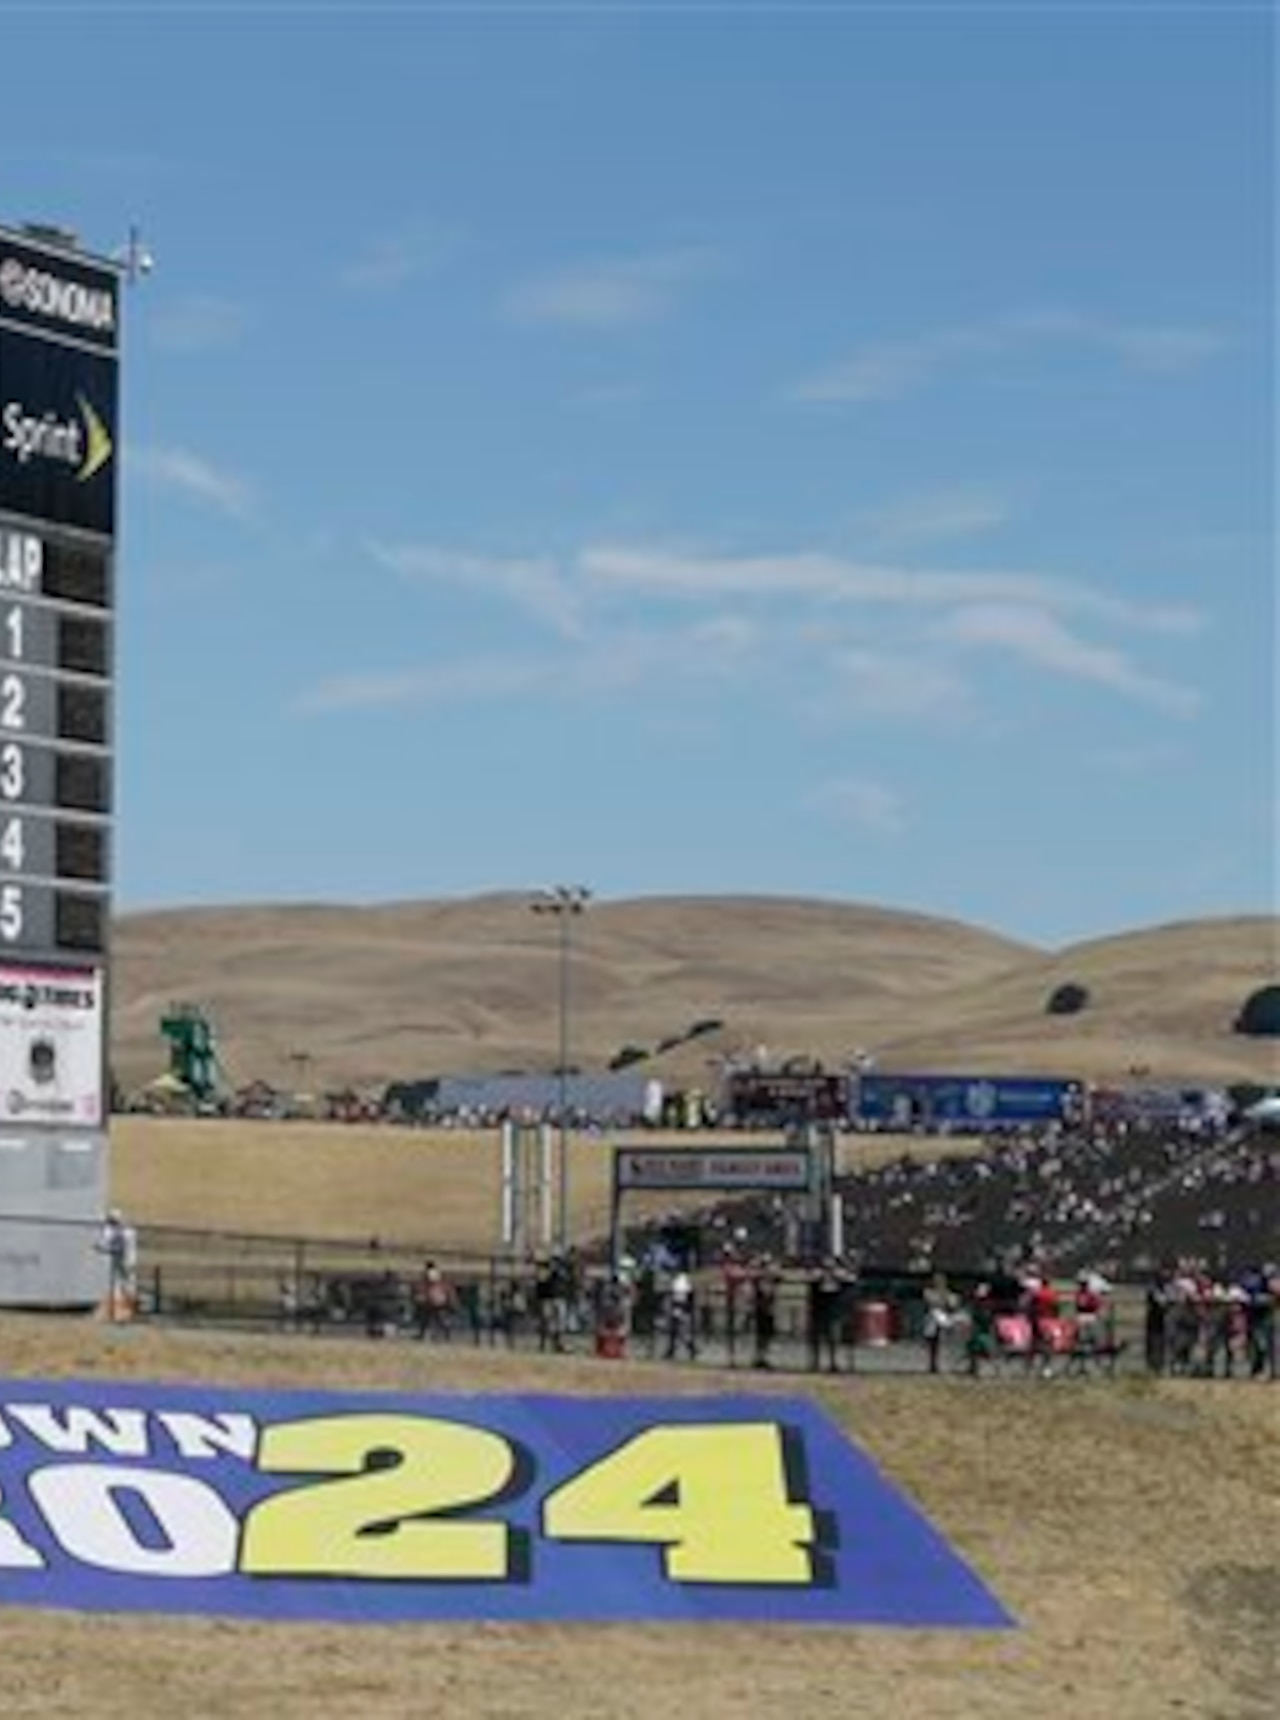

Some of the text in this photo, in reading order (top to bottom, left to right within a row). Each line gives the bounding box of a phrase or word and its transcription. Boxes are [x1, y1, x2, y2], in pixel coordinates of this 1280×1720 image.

[24, 267, 112, 328] SONOMA
[3, 403, 81, 463] Sprint
[7, 607, 22, 657] 1
[0, 675, 25, 728] 2
[0, 745, 24, 799] 3
[0, 818, 24, 868] 4
[42, 986, 94, 1009] TIRES
[239, 1413, 818, 1584] 24
